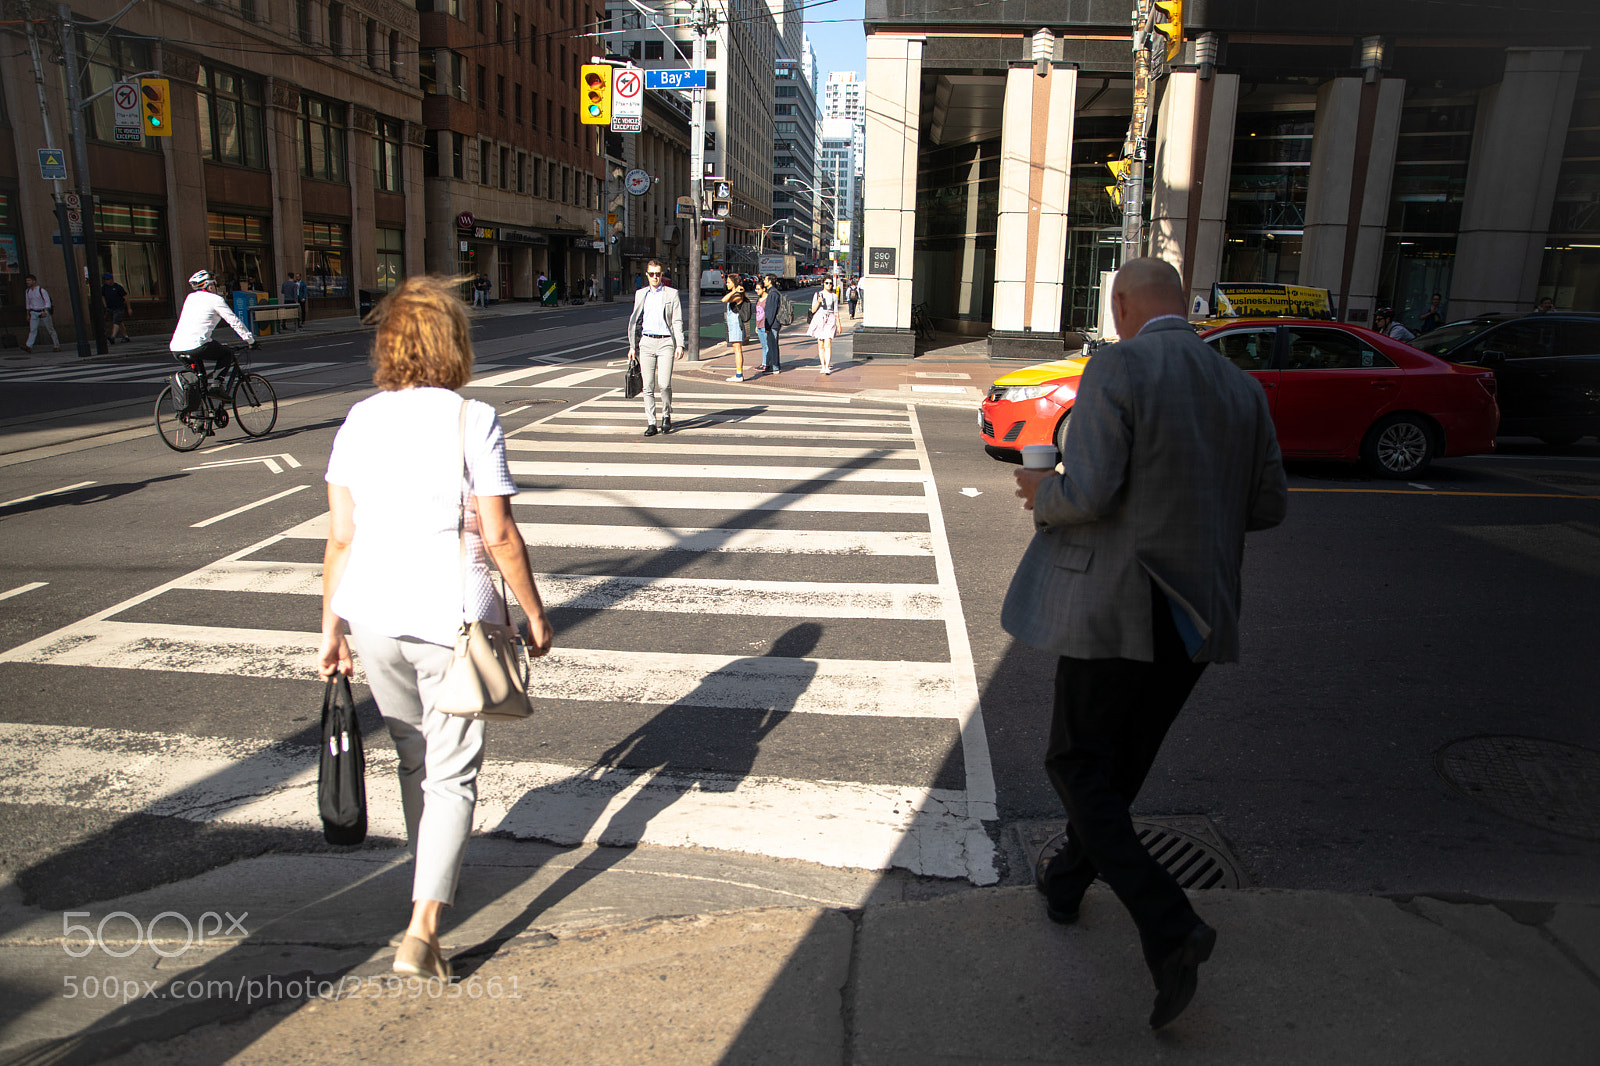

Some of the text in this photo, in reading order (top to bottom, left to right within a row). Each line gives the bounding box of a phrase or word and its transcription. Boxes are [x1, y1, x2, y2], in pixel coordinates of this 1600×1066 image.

[661, 71, 691, 87] Bay St
[874, 252, 890, 260] 390
[874, 261, 890, 269] BAY
[1229, 297, 1315, 306] business.humber.ca
